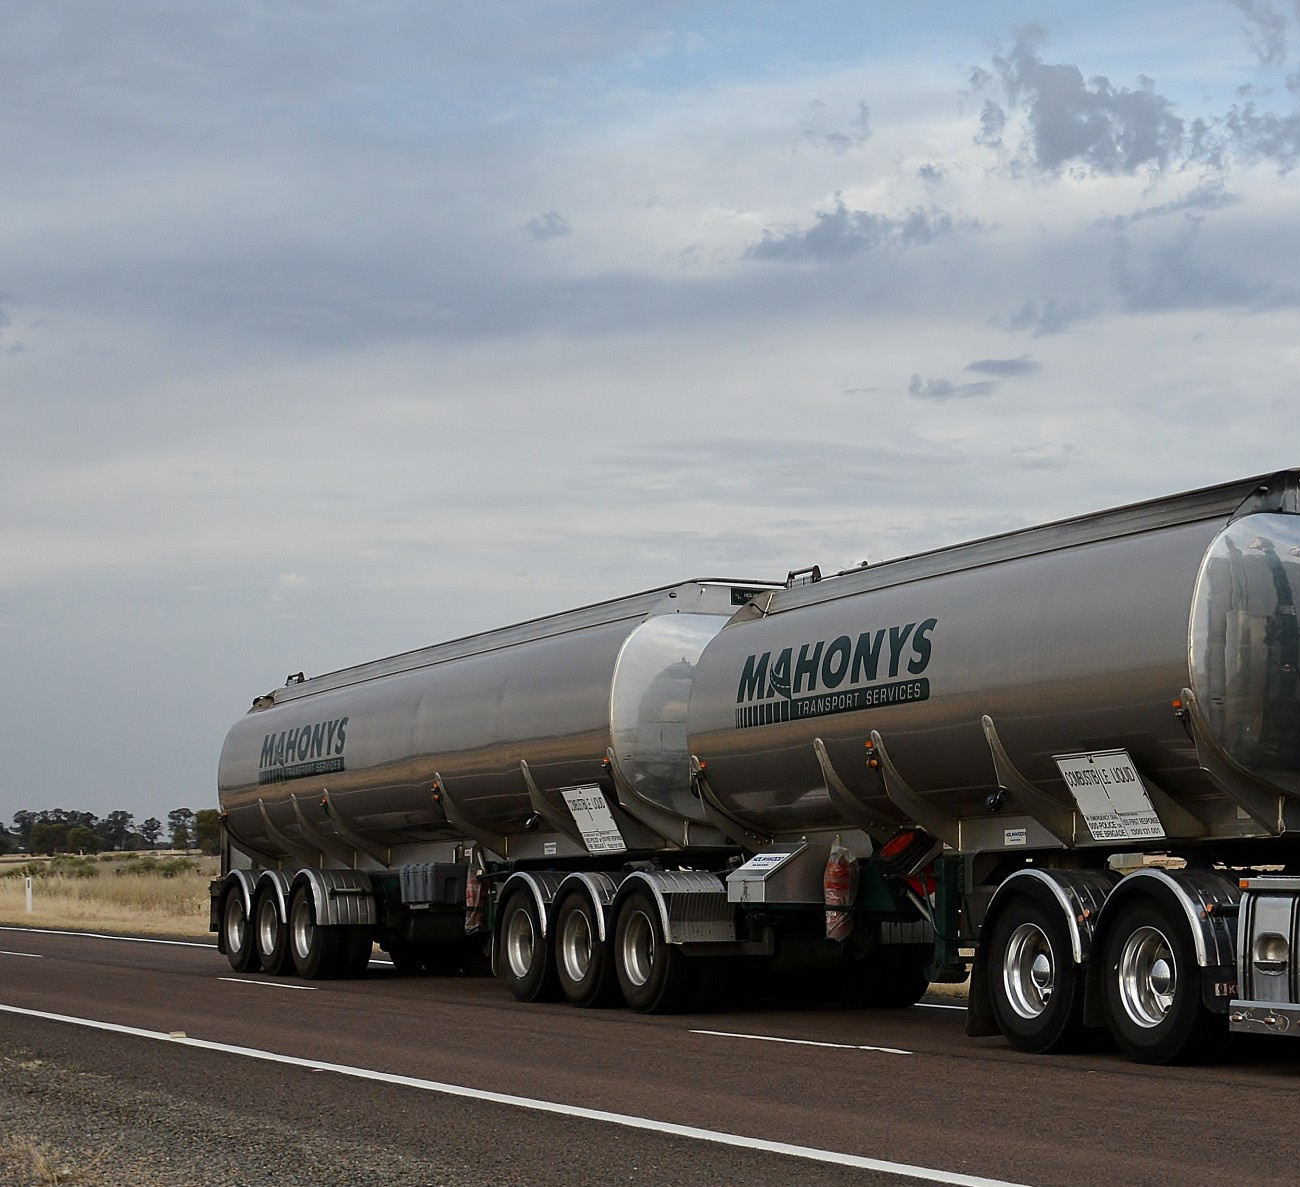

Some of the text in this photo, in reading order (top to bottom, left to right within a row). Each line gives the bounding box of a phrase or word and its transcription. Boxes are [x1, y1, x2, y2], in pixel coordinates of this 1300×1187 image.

[737, 618, 937, 700] MAHONYS
[797, 682, 921, 716] TRANSPORT SERVICES
[259, 717, 349, 769] MAHONYS
[1110, 766, 1136, 783] LIQUID
